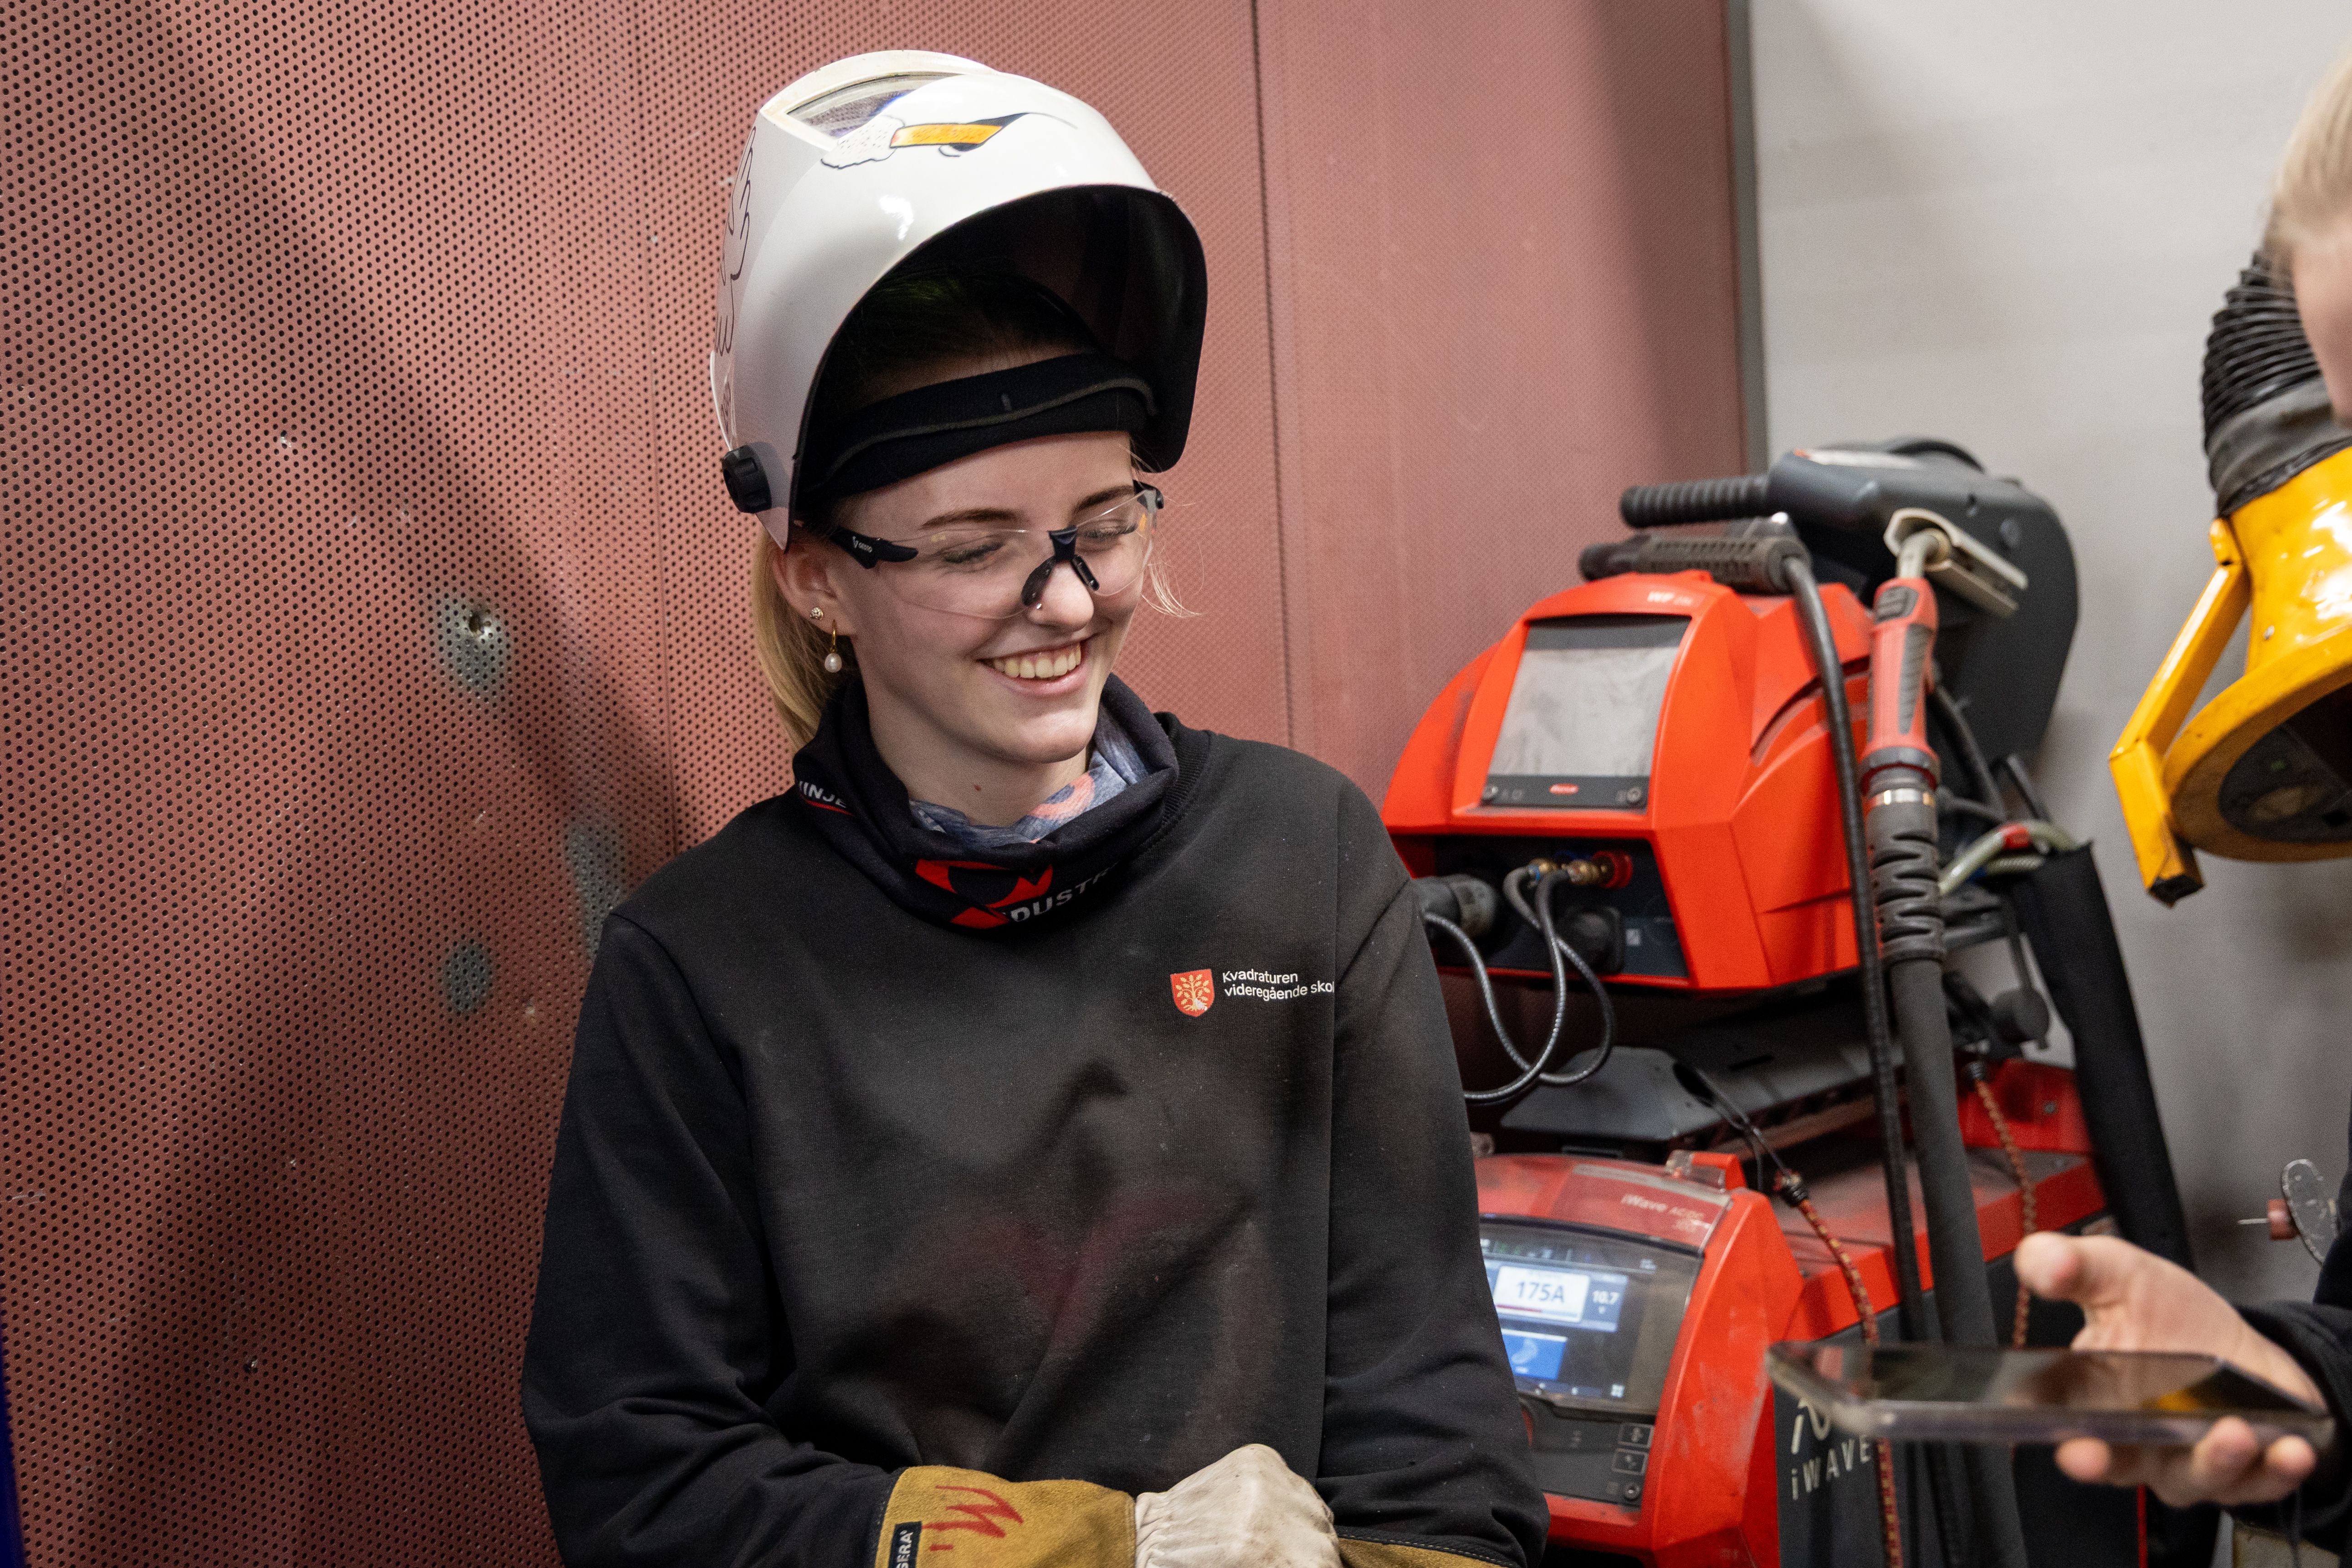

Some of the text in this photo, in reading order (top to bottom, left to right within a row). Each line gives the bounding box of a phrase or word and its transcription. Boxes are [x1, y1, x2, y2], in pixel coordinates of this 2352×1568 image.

[1223, 968, 1298, 984] Kvadraturen
[1224, 983, 1307, 1001] videregående
[1517, 1281, 1565, 1303] 175A
[1791, 1435, 1870, 1501] iWAVE
